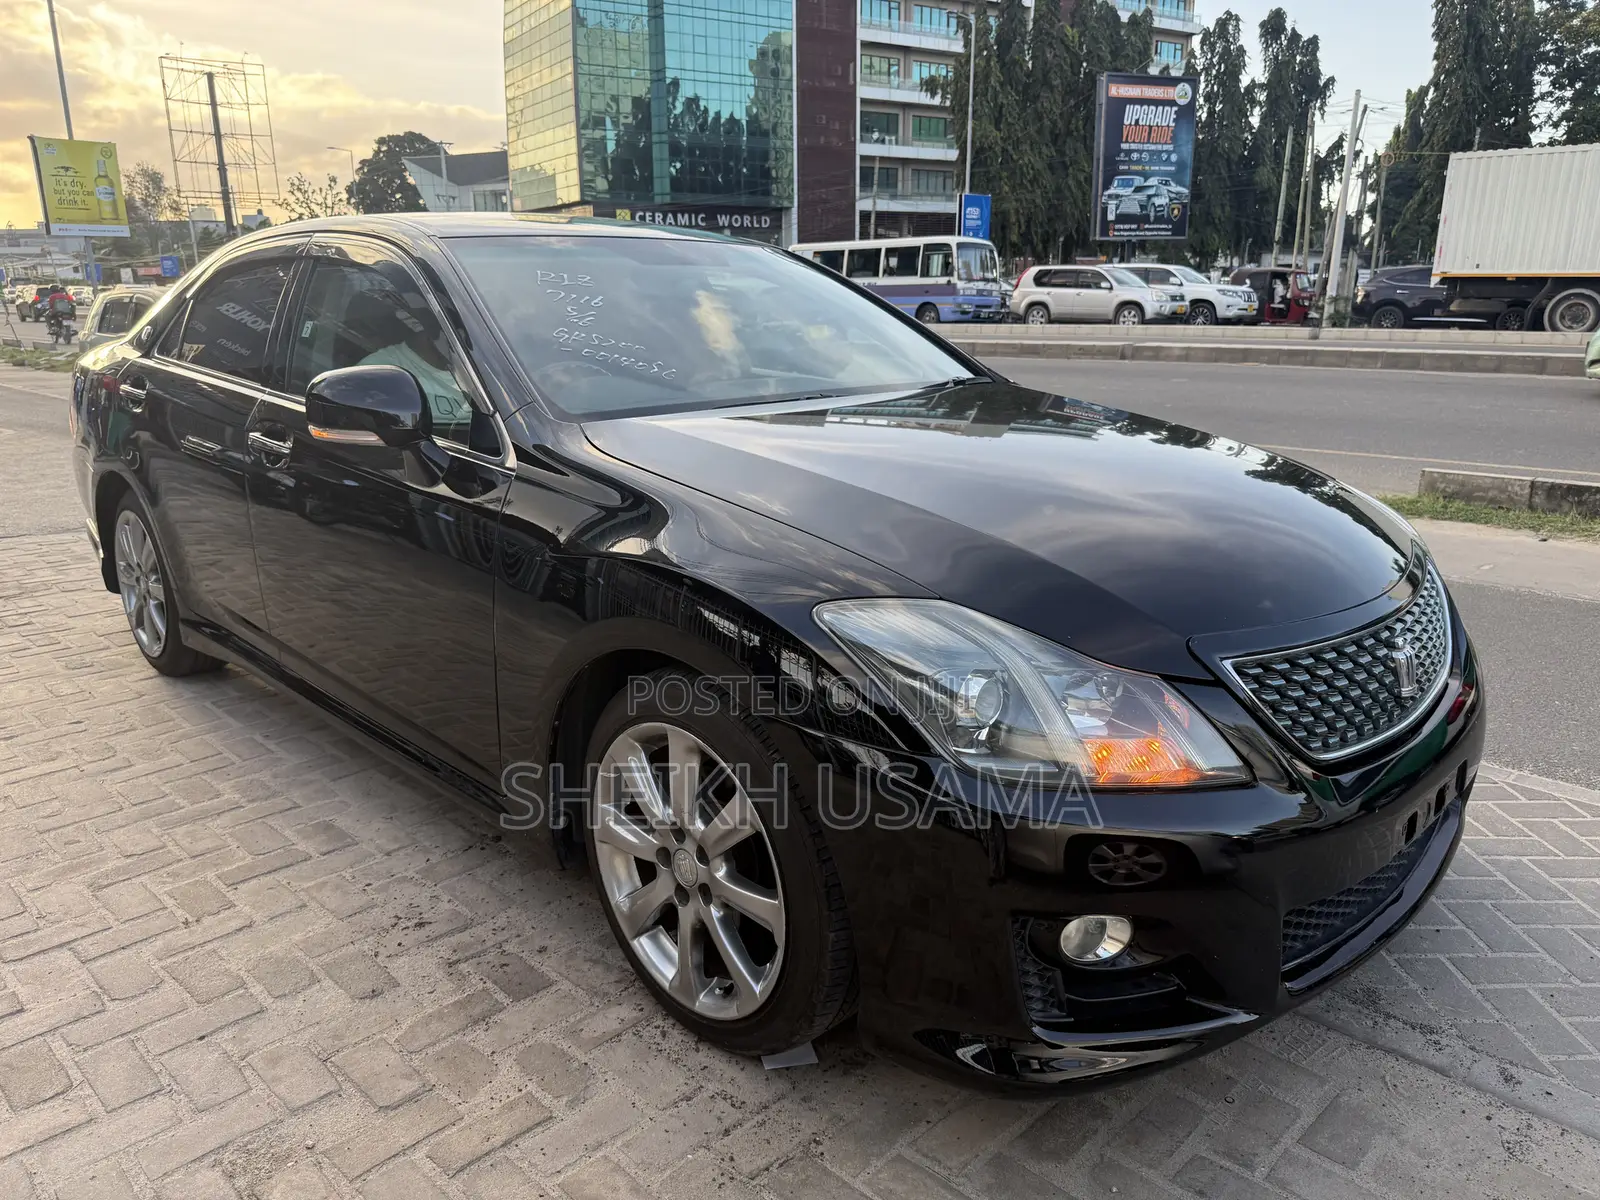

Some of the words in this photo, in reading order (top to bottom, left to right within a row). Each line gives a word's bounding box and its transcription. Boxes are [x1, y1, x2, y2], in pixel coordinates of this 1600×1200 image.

[1142, 87, 1164, 98] TRADERS
[1123, 104, 1178, 127] UPGRADE
[1122, 125, 1149, 143] YOUR
[1150, 126, 1175, 144] RIDE
[70, 179, 87, 190] dry.
[53, 188, 66, 196] but
[67, 189, 80, 197] you
[57, 197, 79, 206] drink
[635, 211, 707, 226] CERAMIC
[717, 214, 771, 228] WORLD
